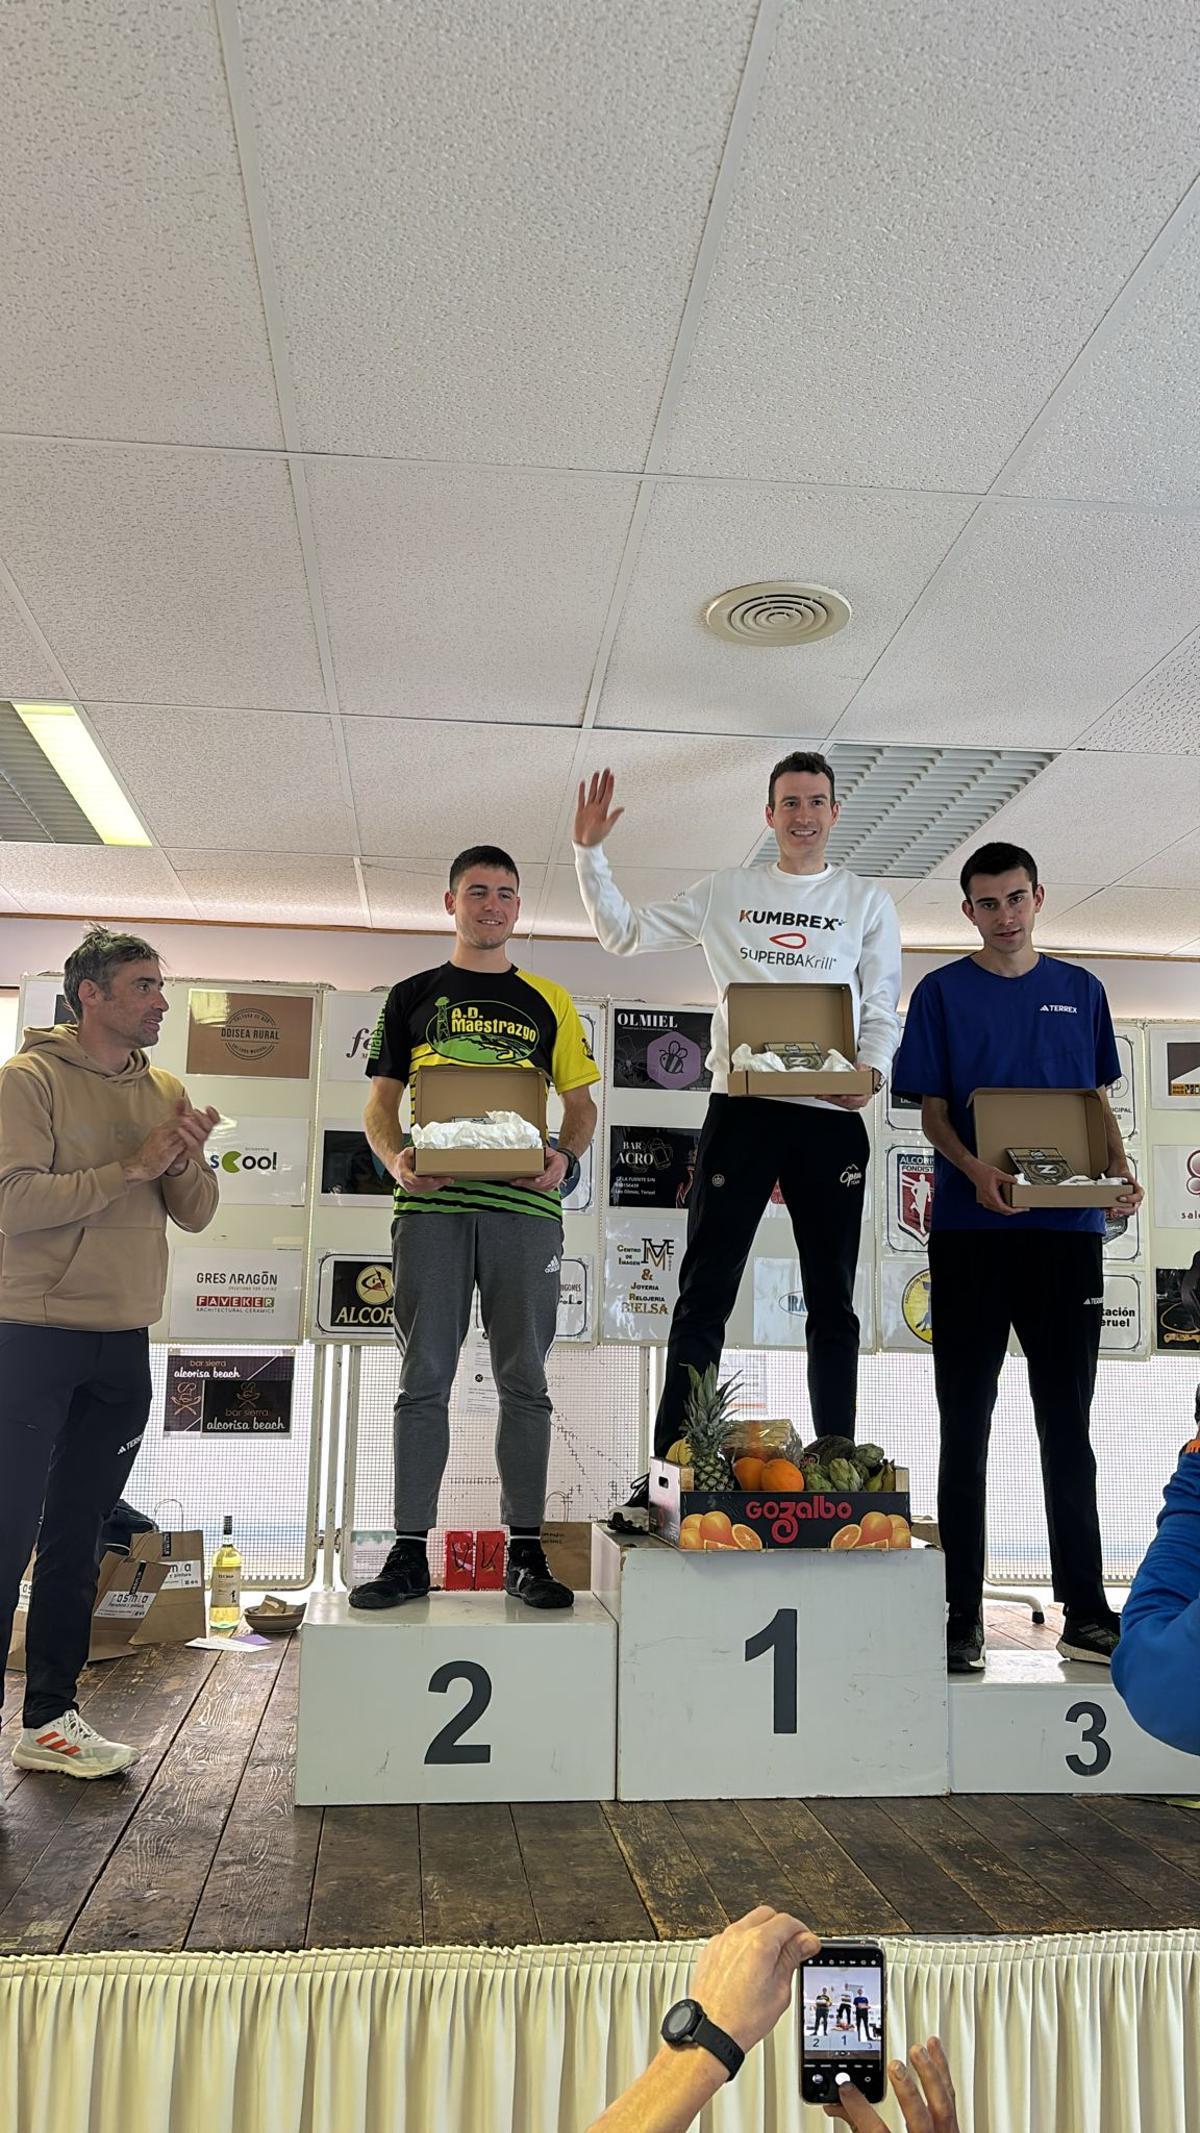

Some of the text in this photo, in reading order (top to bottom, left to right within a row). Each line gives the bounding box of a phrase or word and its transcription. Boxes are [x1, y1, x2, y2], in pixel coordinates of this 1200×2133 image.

[739, 909, 838, 931] KUMBREX
[451, 1007, 484, 1020] A.D.
[1049, 1004, 1078, 1014] TERREX
[617, 1013, 678, 1028] OLMIEL
[220, 1028, 280, 1040] ODISEA RURAL
[451, 1018, 536, 1042] Maestrazgo
[623, 1141, 642, 1150] BAR
[617, 1152, 654, 1165] ACRO
[196, 1273, 227, 1284] GRES
[196, 1296, 274, 1308] FAVEKER
[174, 1367, 240, 1378] alcorisa beach
[206, 1417, 286, 1430] alcorisa beach
[745, 1608, 797, 1733] 1
[424, 1661, 492, 1764] 2
[1065, 1702, 1111, 1776] 3
[841, 2035, 847, 2046] 1
